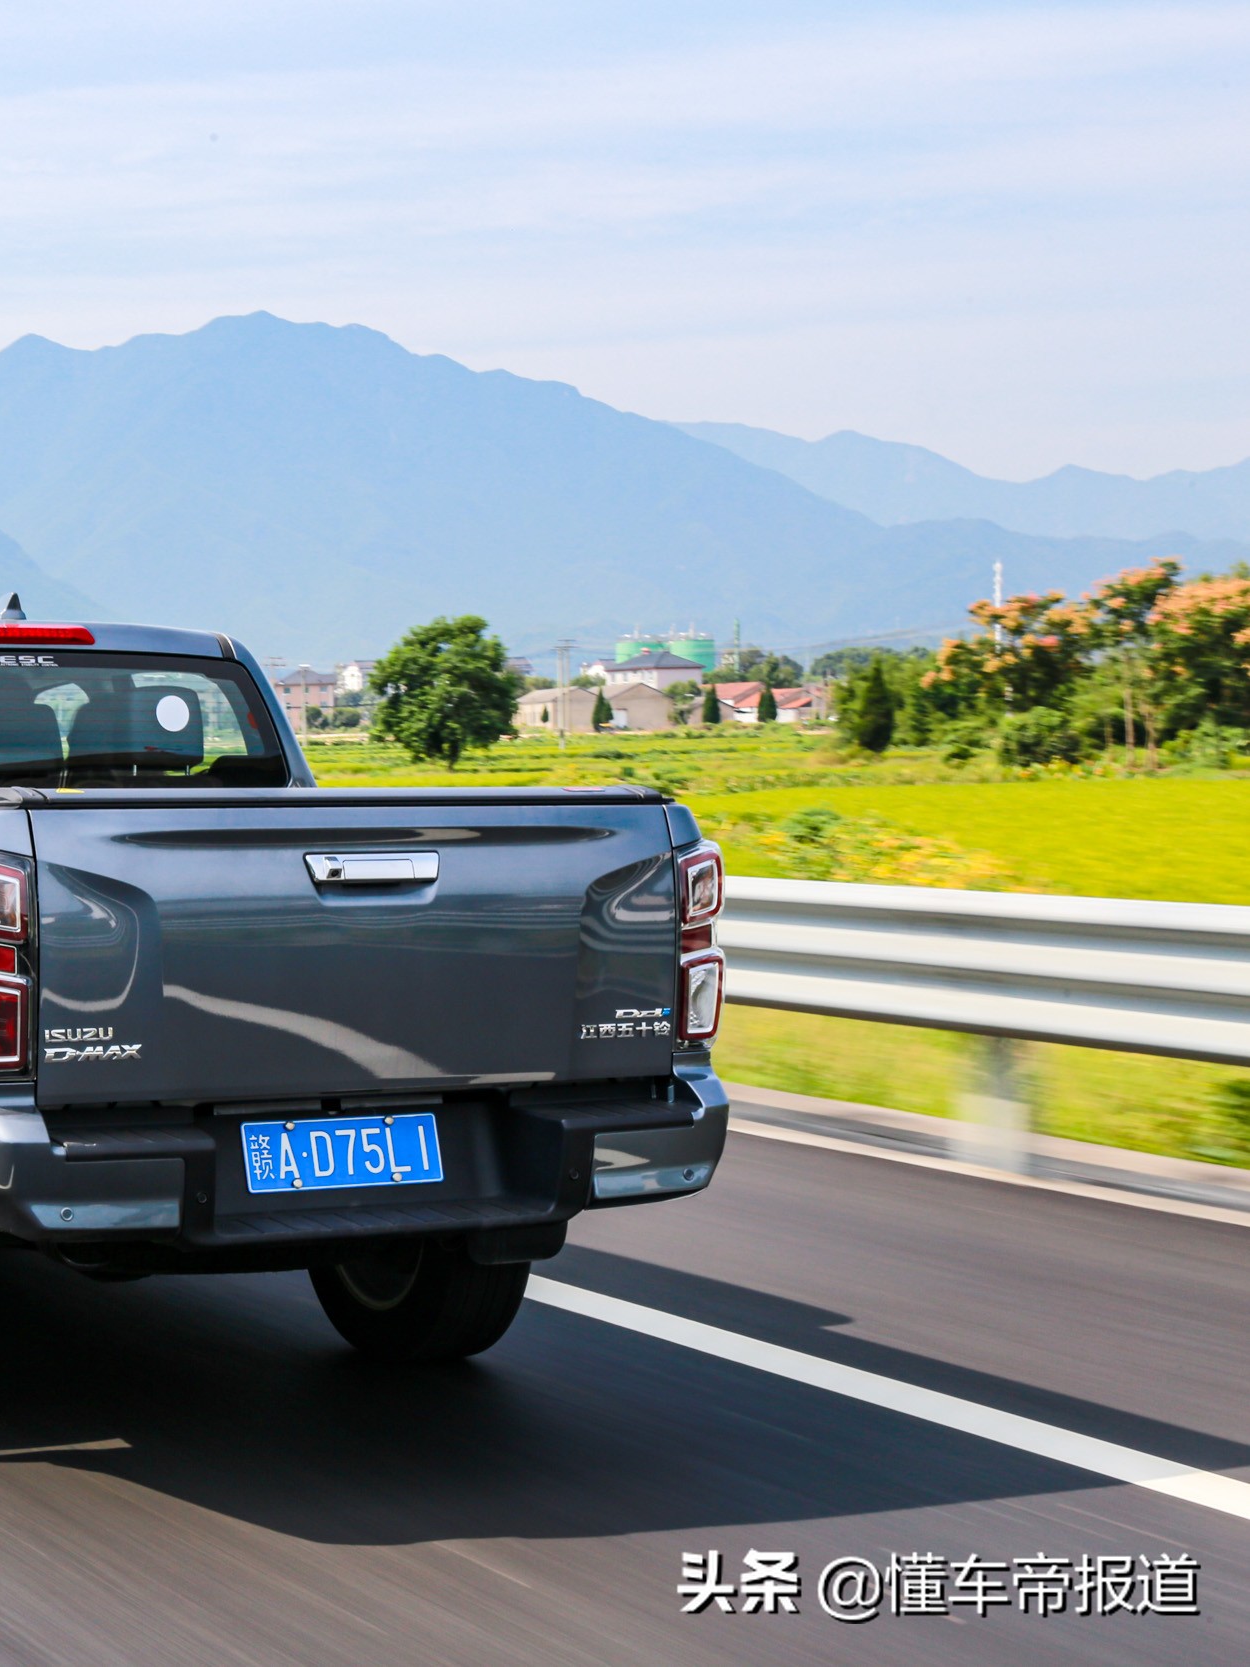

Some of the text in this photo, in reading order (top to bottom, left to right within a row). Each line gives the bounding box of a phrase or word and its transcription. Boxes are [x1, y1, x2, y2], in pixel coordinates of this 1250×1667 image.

[0, 655, 54, 664] ESC
[44, 1027, 113, 1042] ISUZU
[580, 1021, 671, 1039] 江西五十铃
[44, 1044, 142, 1062] D-MAX
